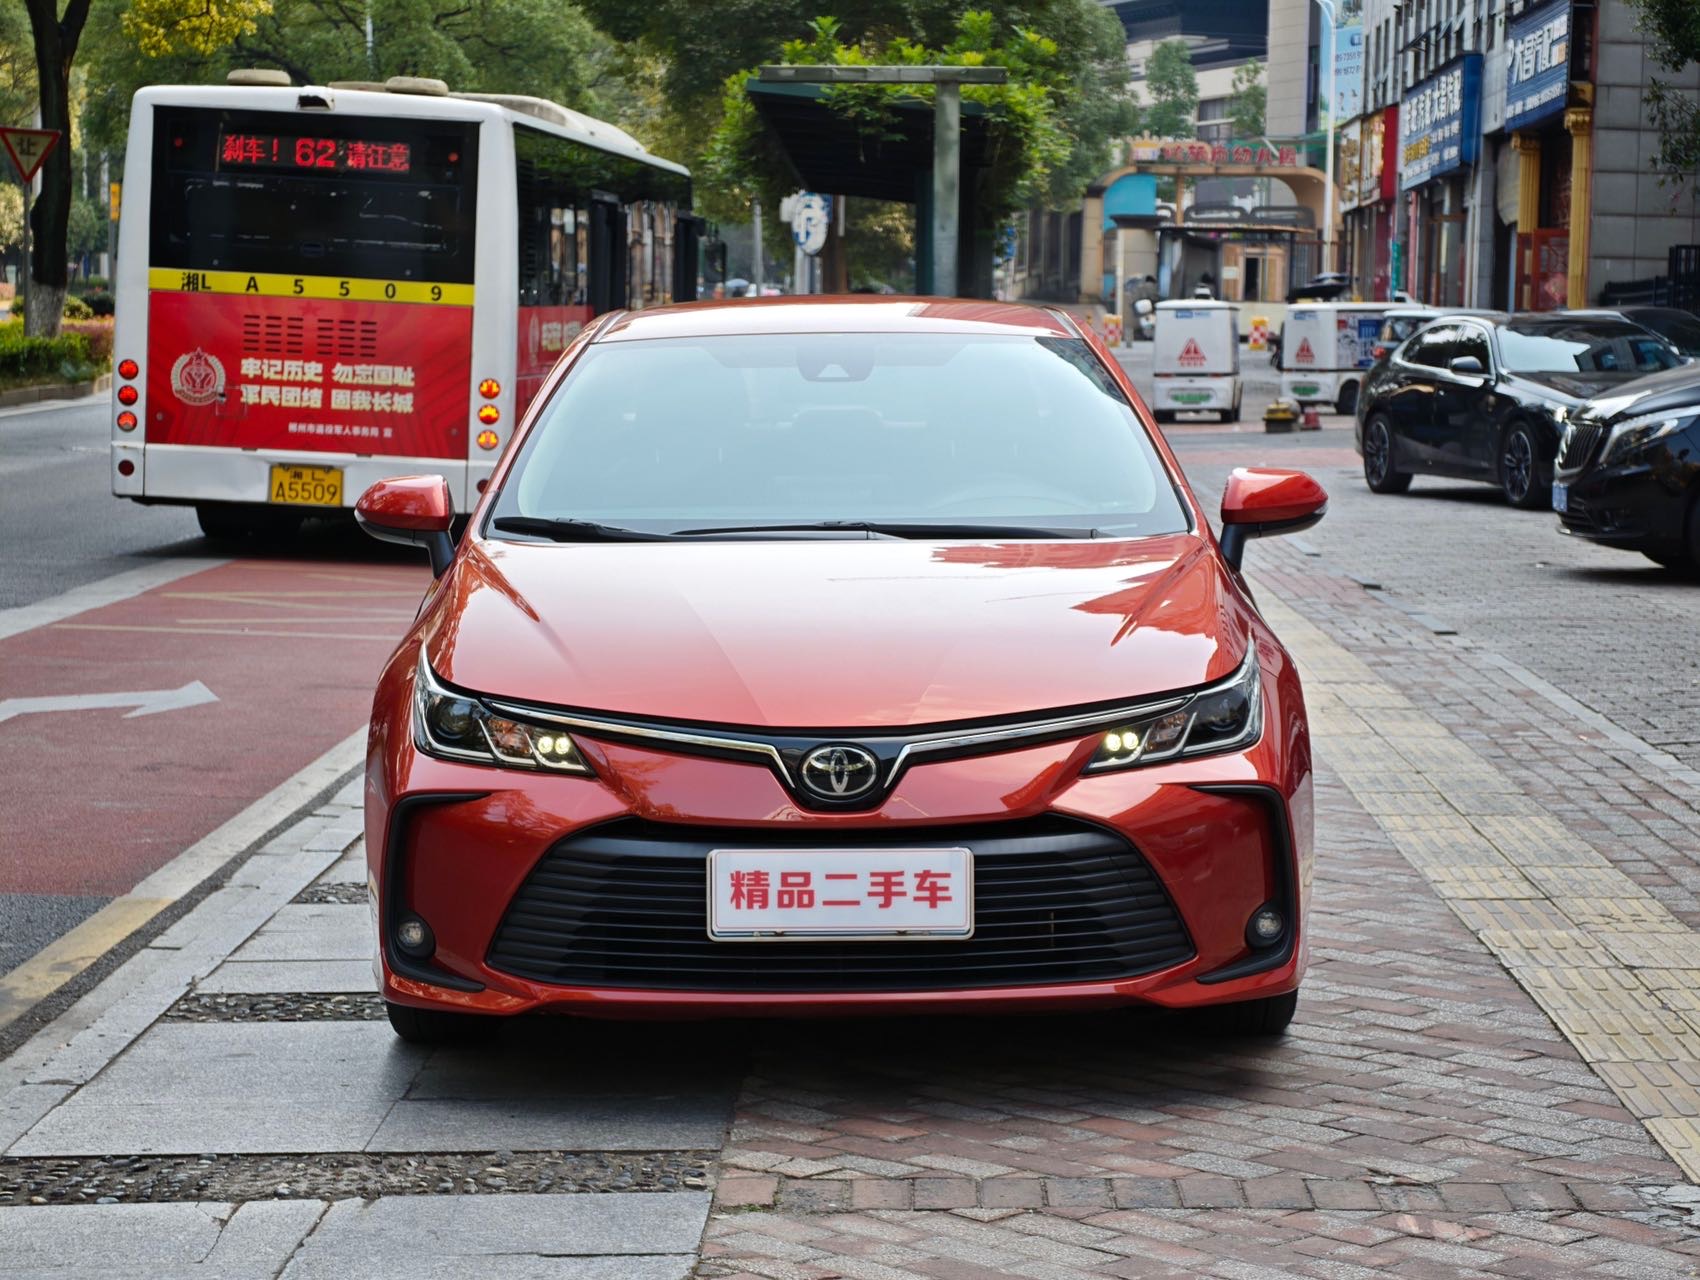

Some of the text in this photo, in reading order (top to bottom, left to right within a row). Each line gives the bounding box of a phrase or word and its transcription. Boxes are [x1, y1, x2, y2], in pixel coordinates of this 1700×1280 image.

[295, 137, 337, 168] 62
[346, 140, 410, 172] 请注意
[181, 271, 442, 301] 湘L A 5 5 0 9
[240, 358, 415, 387] 牢记历史 勿忘国耻
[240, 384, 323, 409] 军民团结
[330, 388, 414, 414] 固我长城
[275, 480, 338, 503] A5509
[729, 869, 953, 910] 精品二手车
